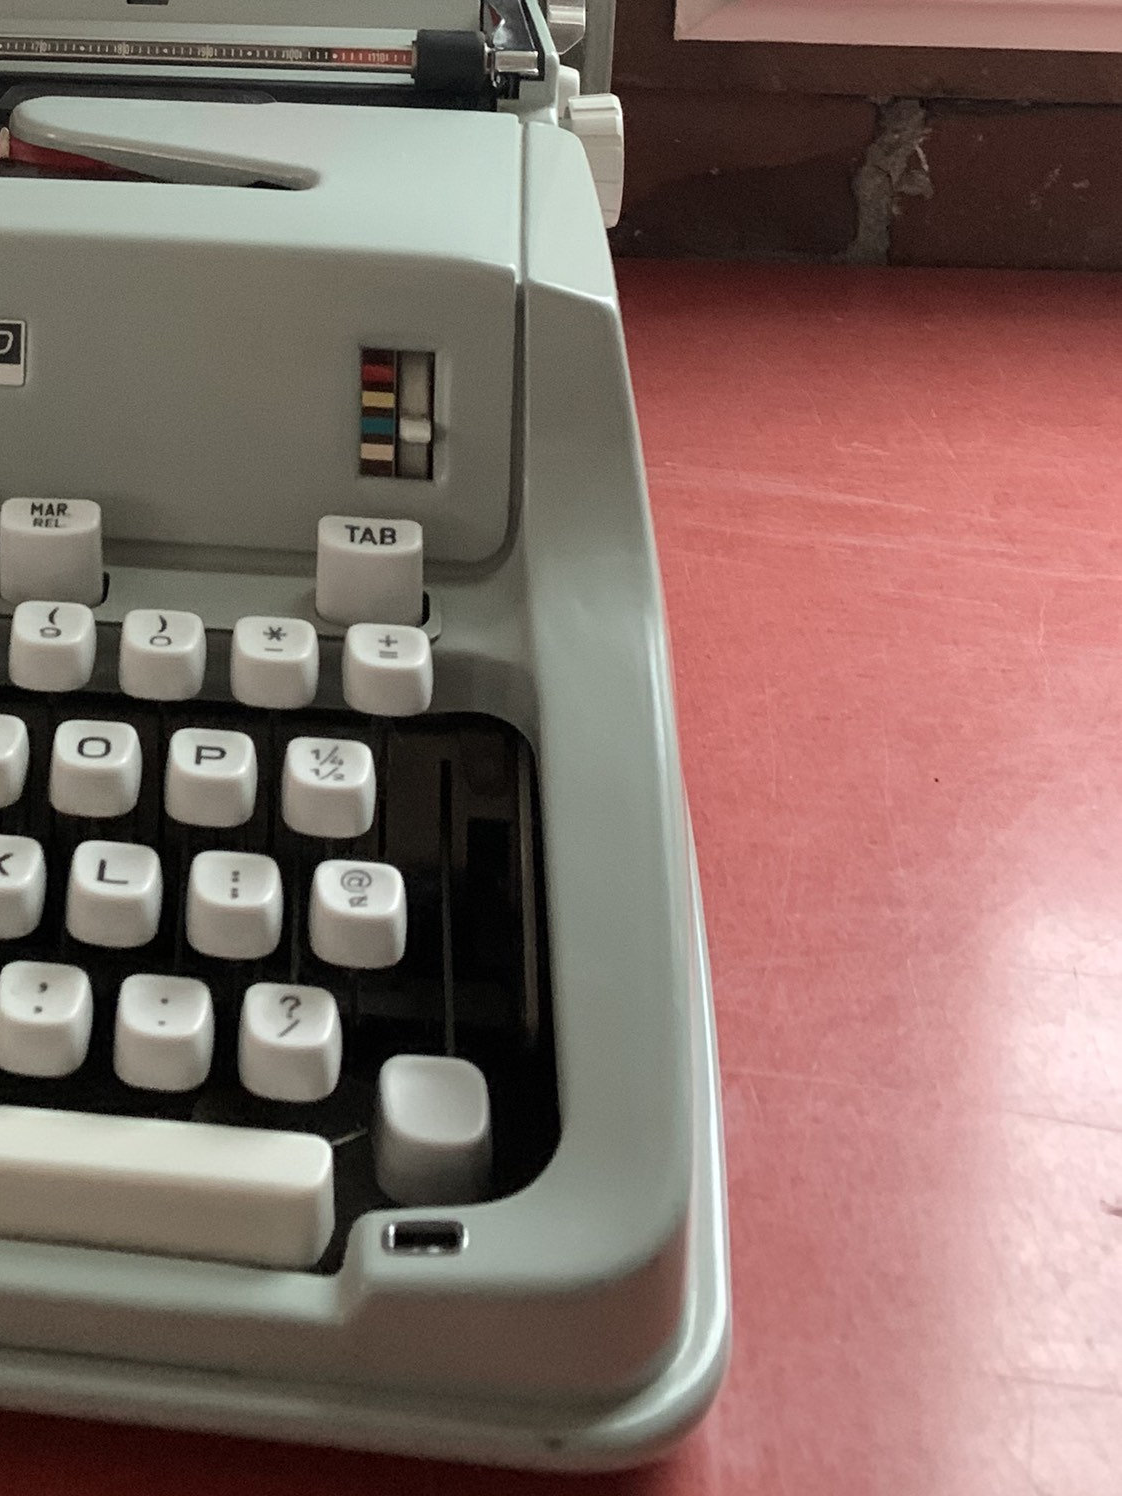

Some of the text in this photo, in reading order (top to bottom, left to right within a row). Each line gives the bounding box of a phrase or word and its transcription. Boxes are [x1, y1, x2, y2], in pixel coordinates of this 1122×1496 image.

[344, 524, 397, 546] TAB
[77, 737, 111, 759] O
[196, 745, 227, 765] P
[96, 860, 129, 884] L
[340, 870, 372, 893] @
[280, 995, 302, 1019] ?
[278, 1019, 300, 1037] /
